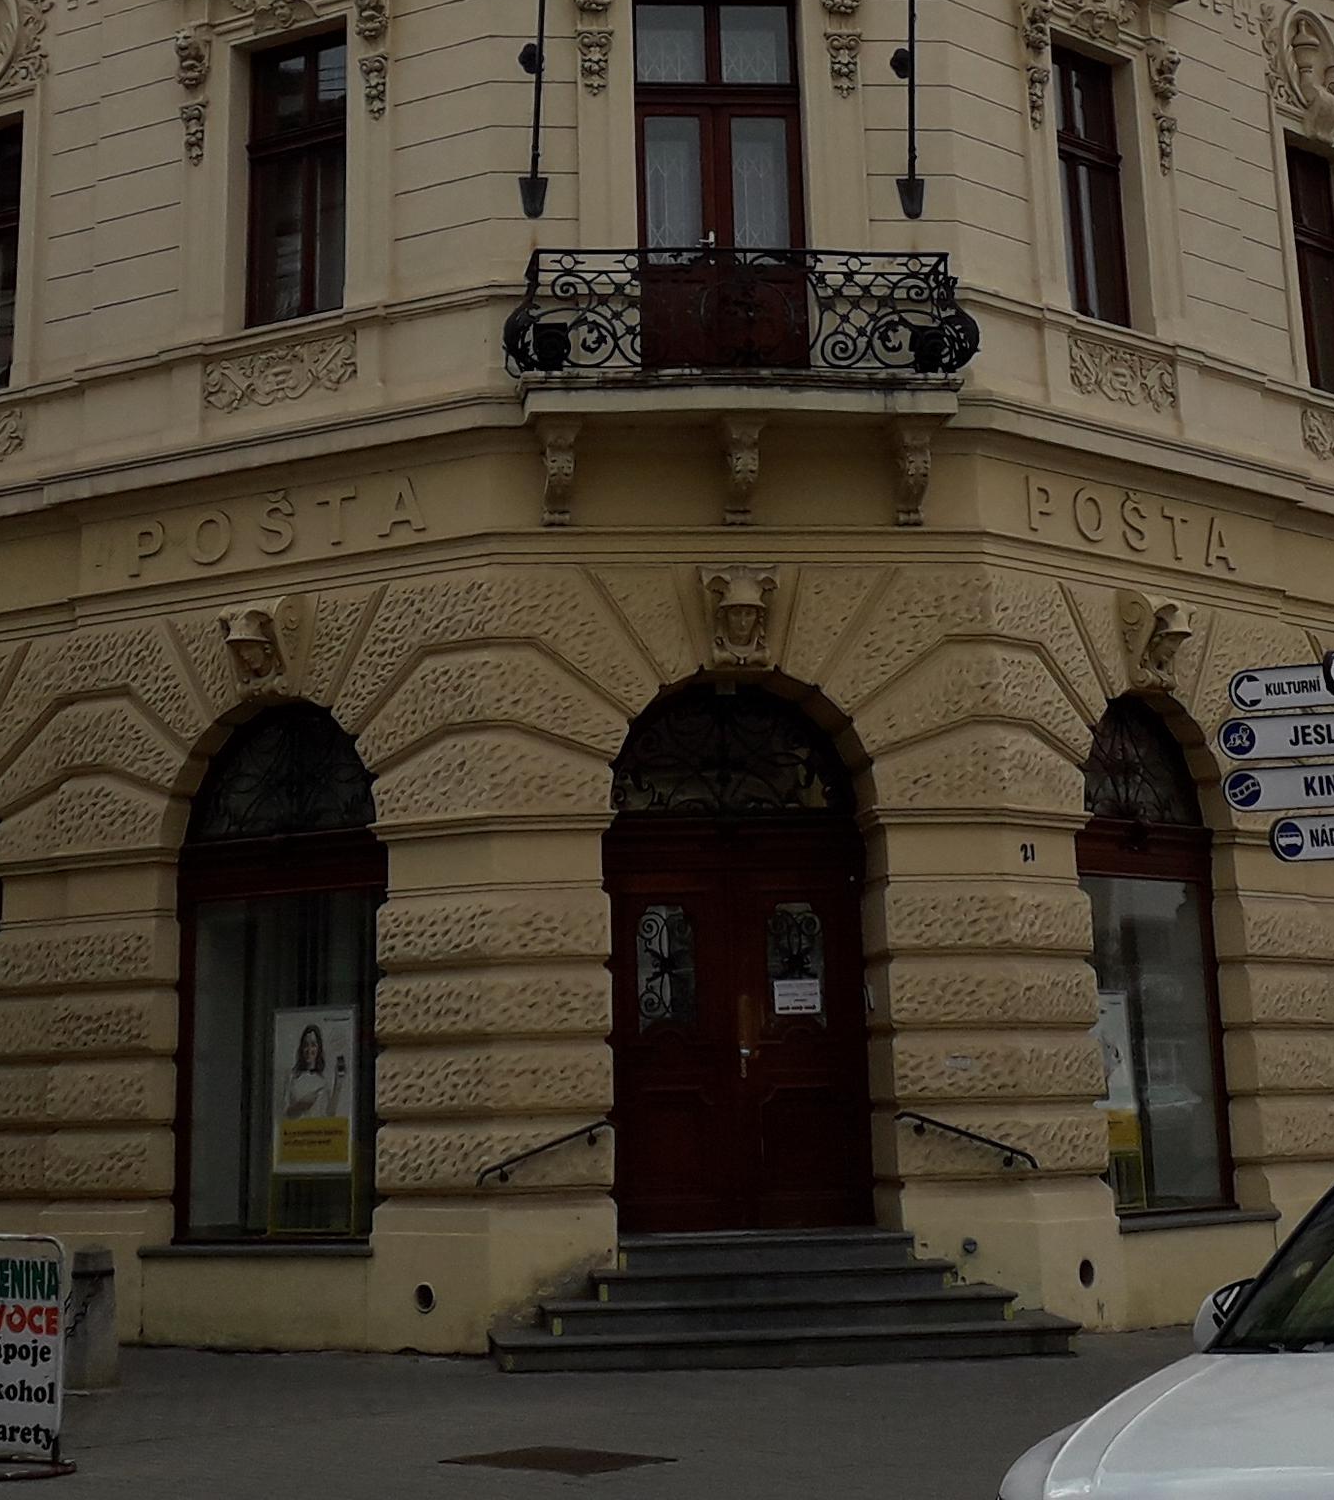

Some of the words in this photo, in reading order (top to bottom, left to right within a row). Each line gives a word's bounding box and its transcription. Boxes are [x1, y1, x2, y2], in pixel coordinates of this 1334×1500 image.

[128, 475, 427, 578] POŠTA
[1025, 474, 1237, 571] POŠTA
[1265, 676, 1321, 696] KULTURNÍ
[1020, 843, 1035, 862] 21
